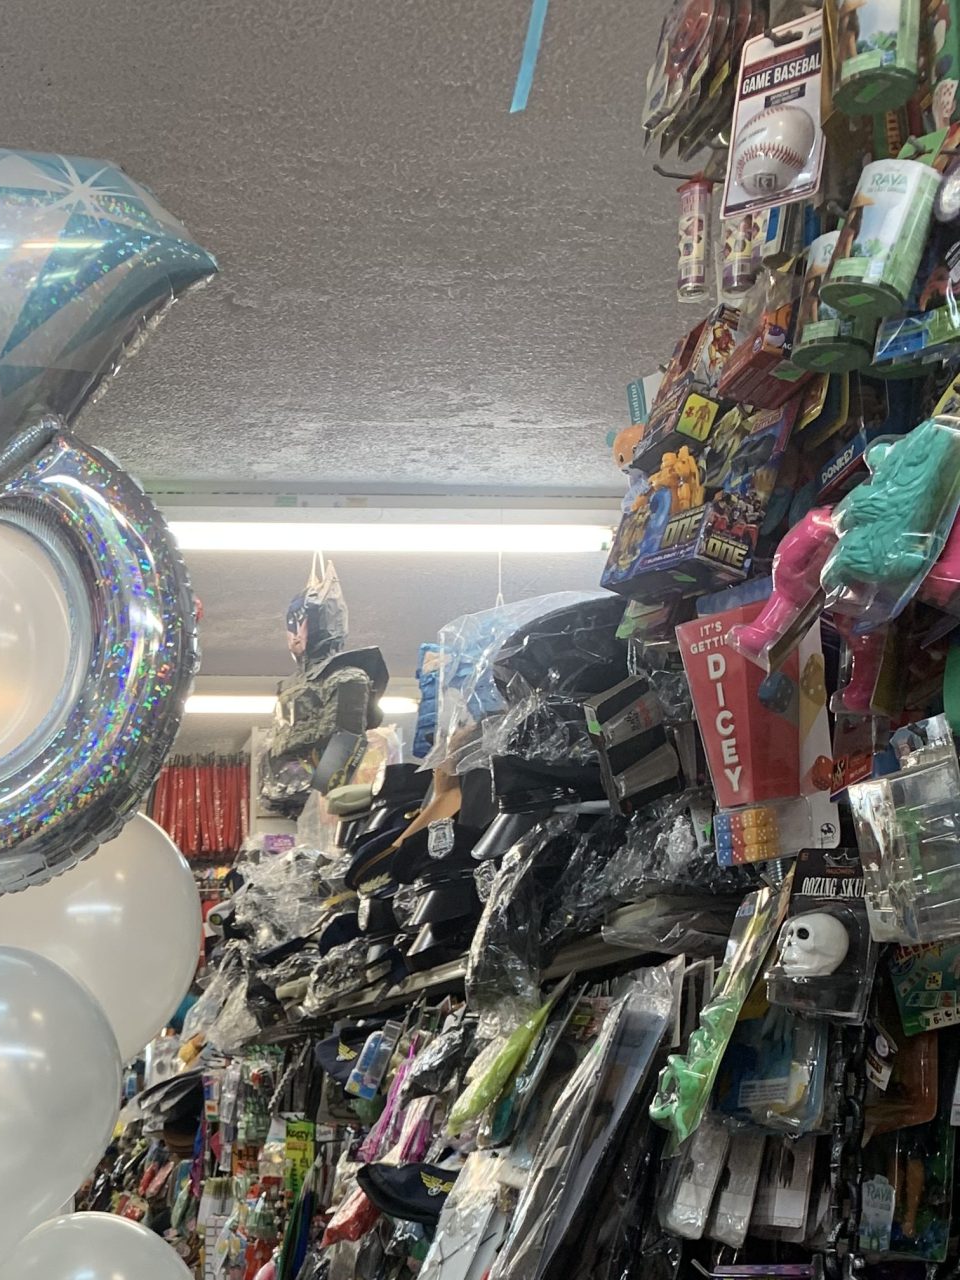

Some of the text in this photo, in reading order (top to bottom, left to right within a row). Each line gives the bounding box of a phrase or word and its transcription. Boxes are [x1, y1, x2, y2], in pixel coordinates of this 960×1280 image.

[742, 70, 772, 94] GAME
[706, 536, 748, 570] ONE
[699, 621, 722, 637] IT'S
[707, 653, 743, 793] DICEY
[801, 876, 837, 897] OOZING
